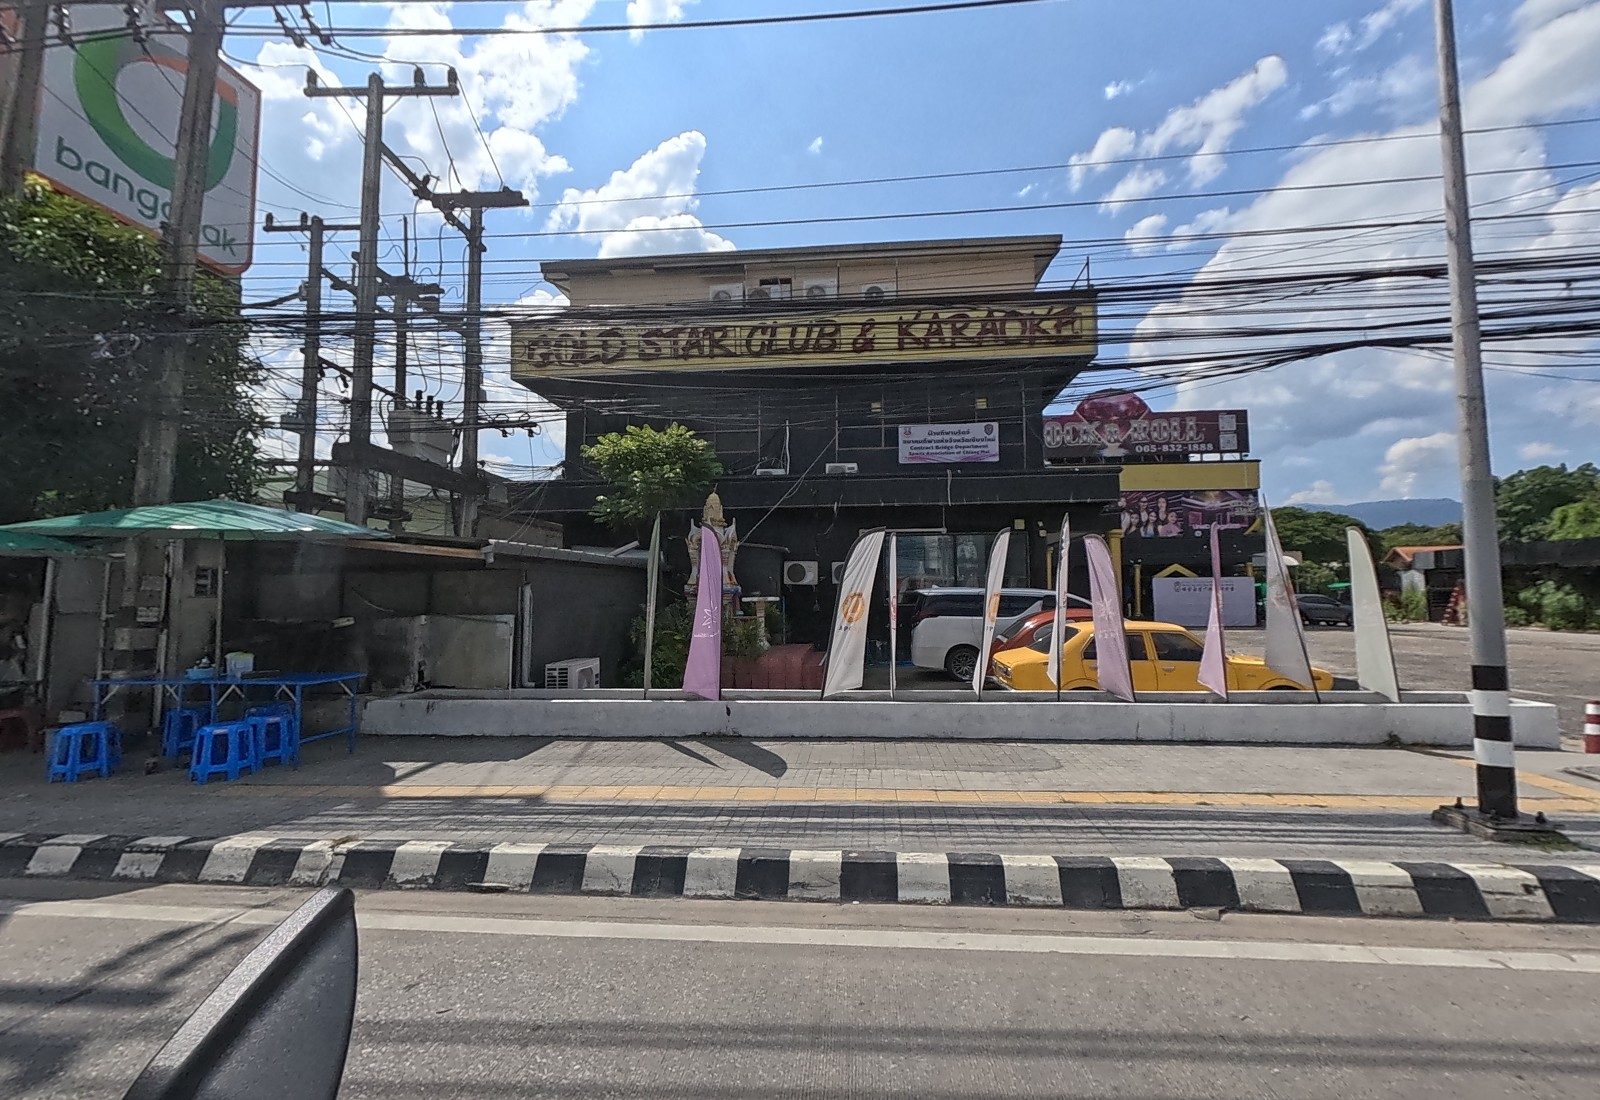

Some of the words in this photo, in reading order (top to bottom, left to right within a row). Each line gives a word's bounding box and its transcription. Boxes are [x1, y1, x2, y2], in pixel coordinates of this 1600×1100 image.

[639, 326, 738, 361] STAR
[746, 318, 841, 355] CLUB
[852, 317, 876, 353] &
[897, 305, 1084, 350] KARAOKE
[1130, 417, 1204, 443] ROLL
